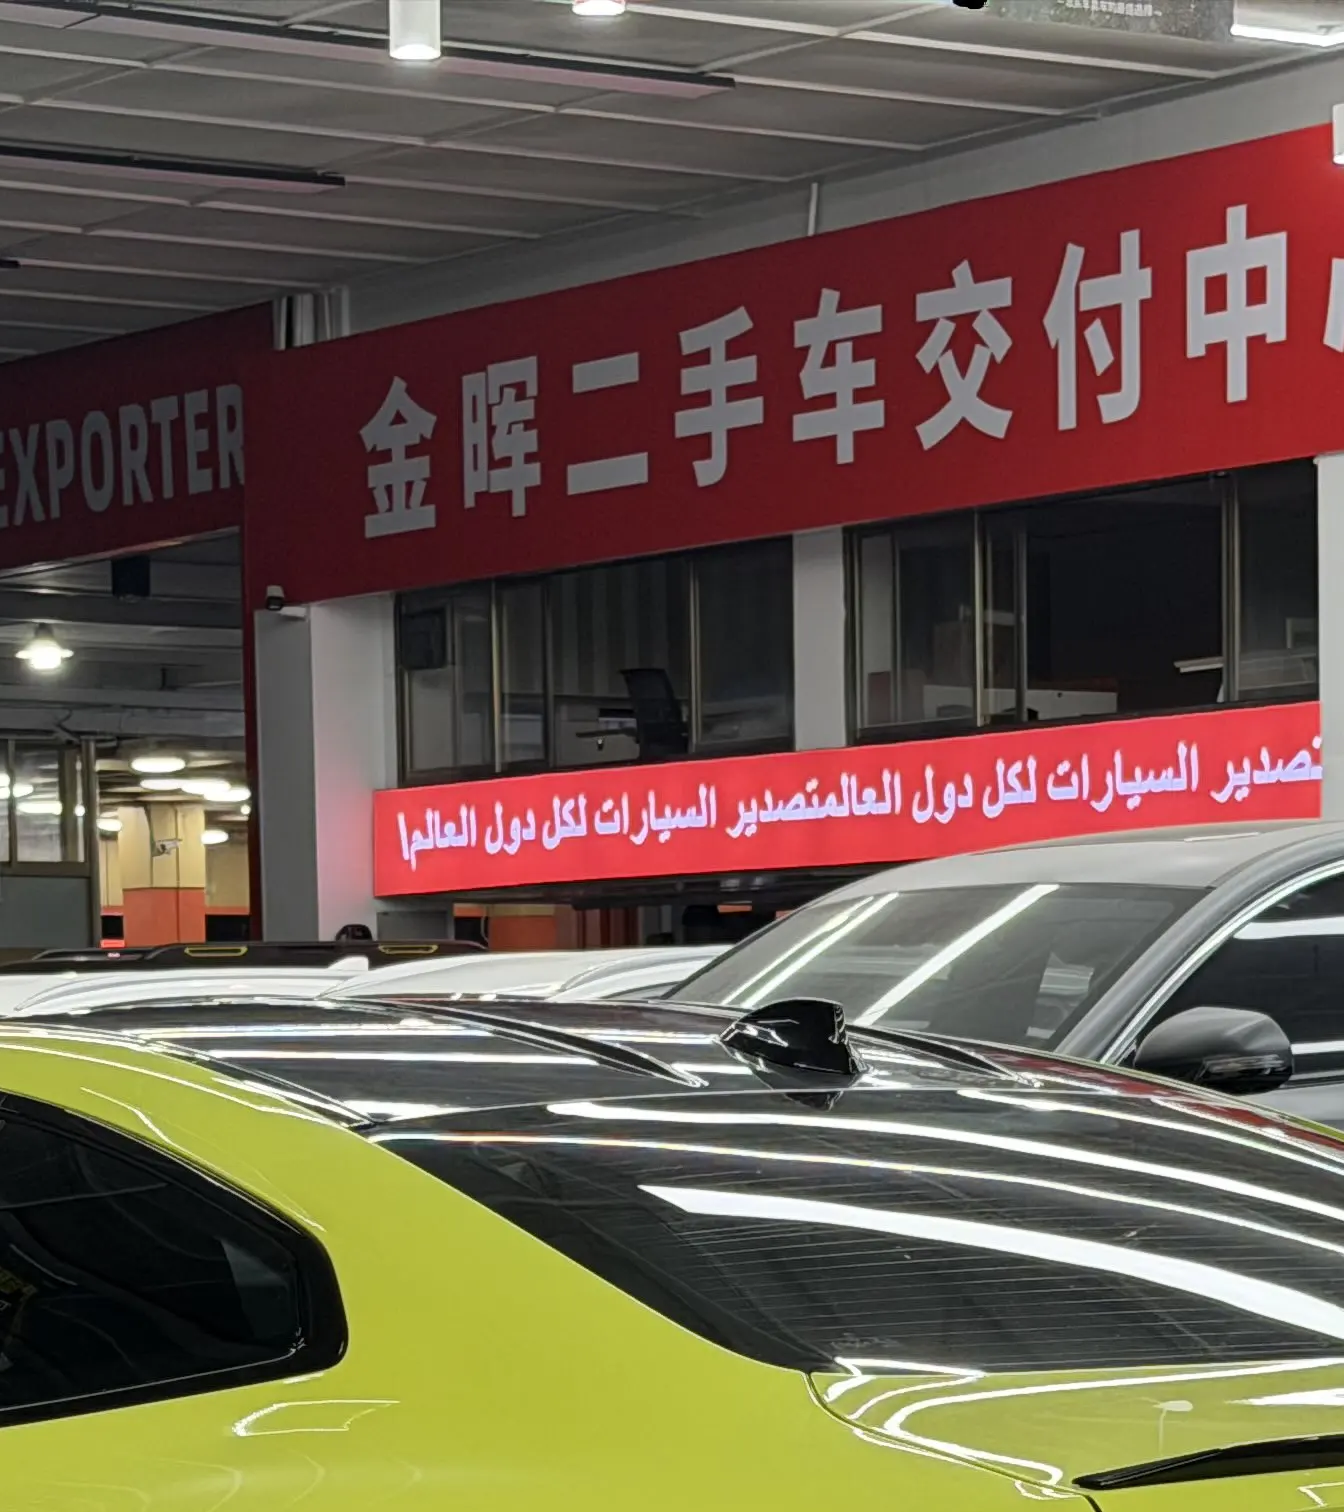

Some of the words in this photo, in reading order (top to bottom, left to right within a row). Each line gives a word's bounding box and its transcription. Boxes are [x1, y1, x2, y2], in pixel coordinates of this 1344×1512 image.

[912, 764, 974, 824] دول
[982, 754, 1037, 819] لكل
[1046, 740, 1199, 813] السيارات
[484, 800, 536, 856] دول
[542, 792, 588, 851] لكل
[594, 783, 717, 846] السيارات
